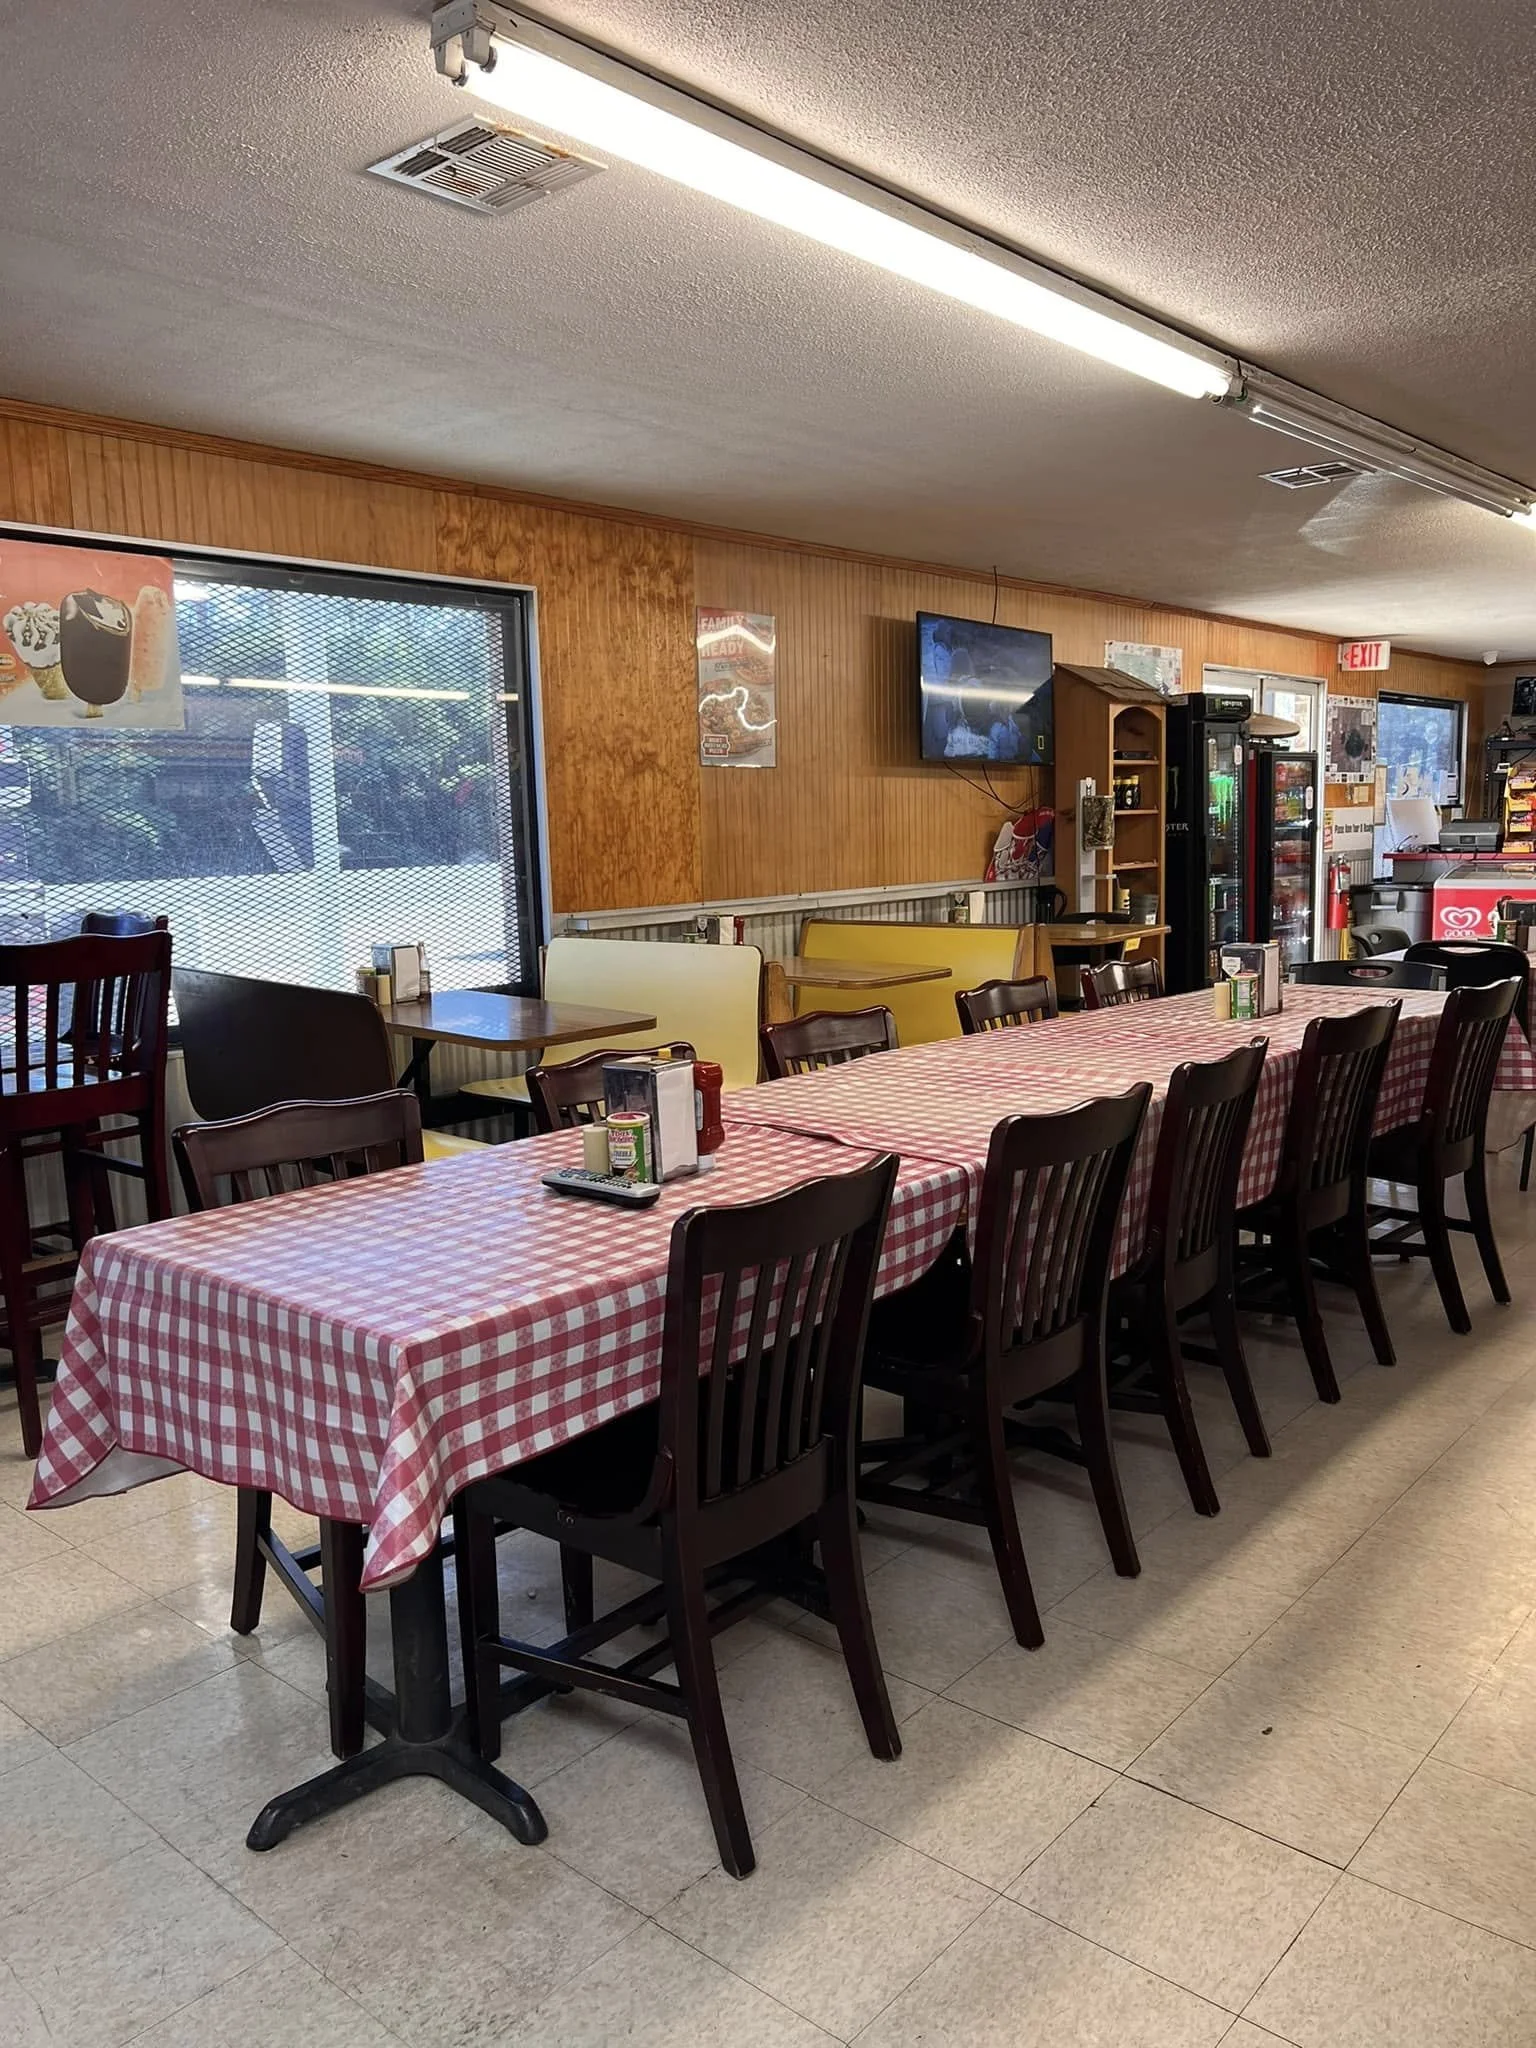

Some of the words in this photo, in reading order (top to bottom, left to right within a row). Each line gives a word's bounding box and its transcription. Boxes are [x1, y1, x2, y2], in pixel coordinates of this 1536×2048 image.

[701, 616, 744, 631] FAMILY
[1350, 643, 1382, 668] EXIT
[1444, 928, 1475, 938] GOOD
